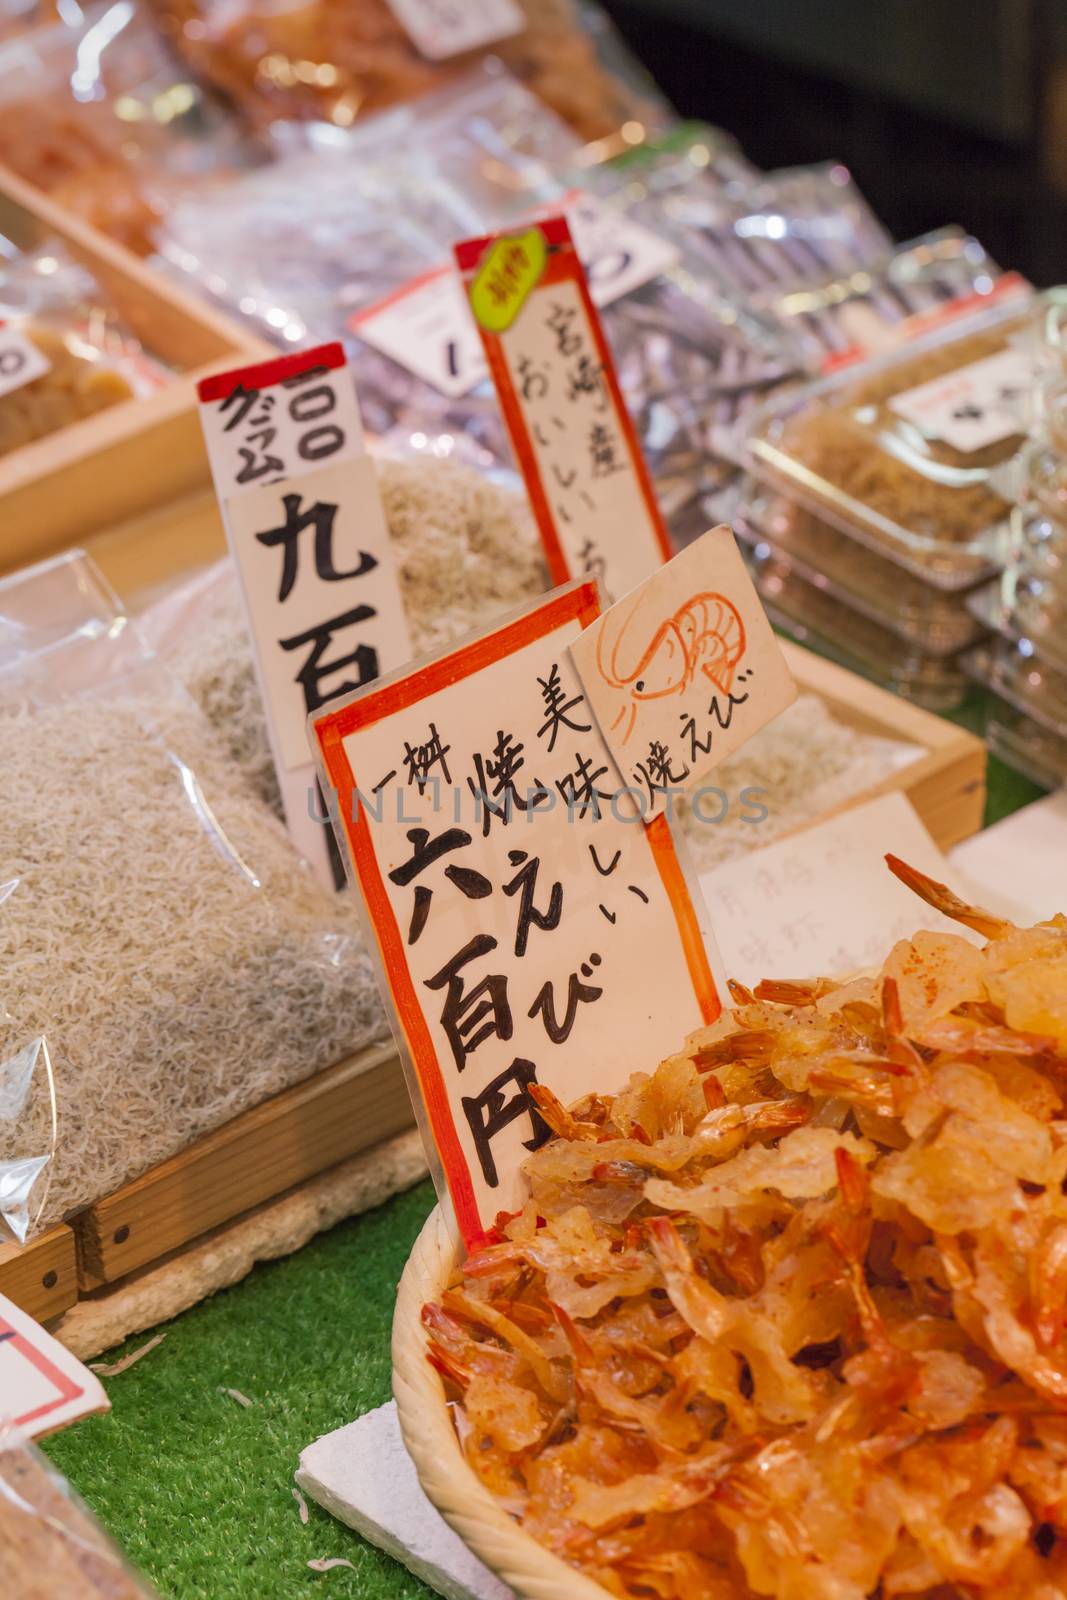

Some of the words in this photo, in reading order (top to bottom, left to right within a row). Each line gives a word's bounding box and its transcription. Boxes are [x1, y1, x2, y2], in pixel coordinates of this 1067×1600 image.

[218, 384, 286, 485] グラム
[536, 663, 649, 925] 美味しい
[632, 669, 754, 811] 焼えび
[388, 827, 555, 1188] 六百円
[466, 729, 604, 1045] 焼えび
